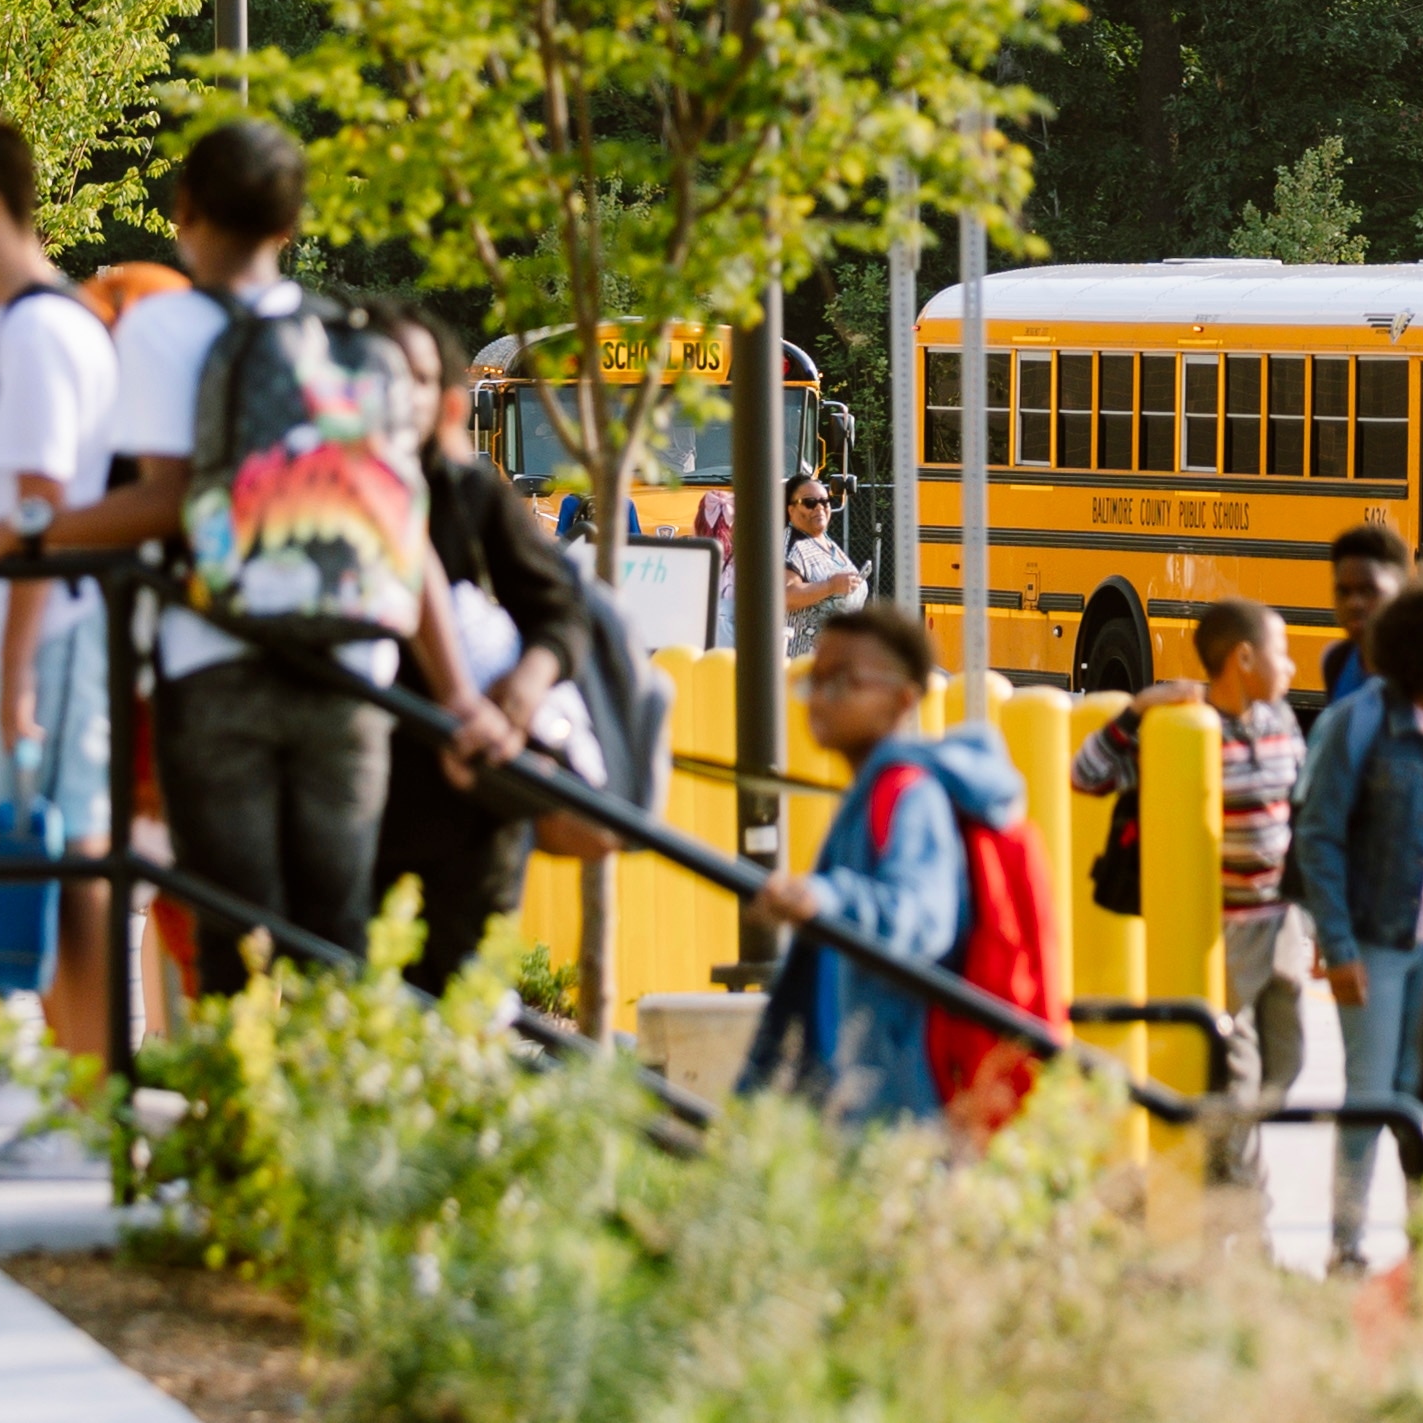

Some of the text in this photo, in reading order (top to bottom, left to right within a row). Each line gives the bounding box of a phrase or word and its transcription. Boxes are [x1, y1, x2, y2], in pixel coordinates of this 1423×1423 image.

[683, 342, 720, 370] BUS
[1092, 497, 1250, 530] BALTIMORE COUNTY PUBLIC SCHOOLS
